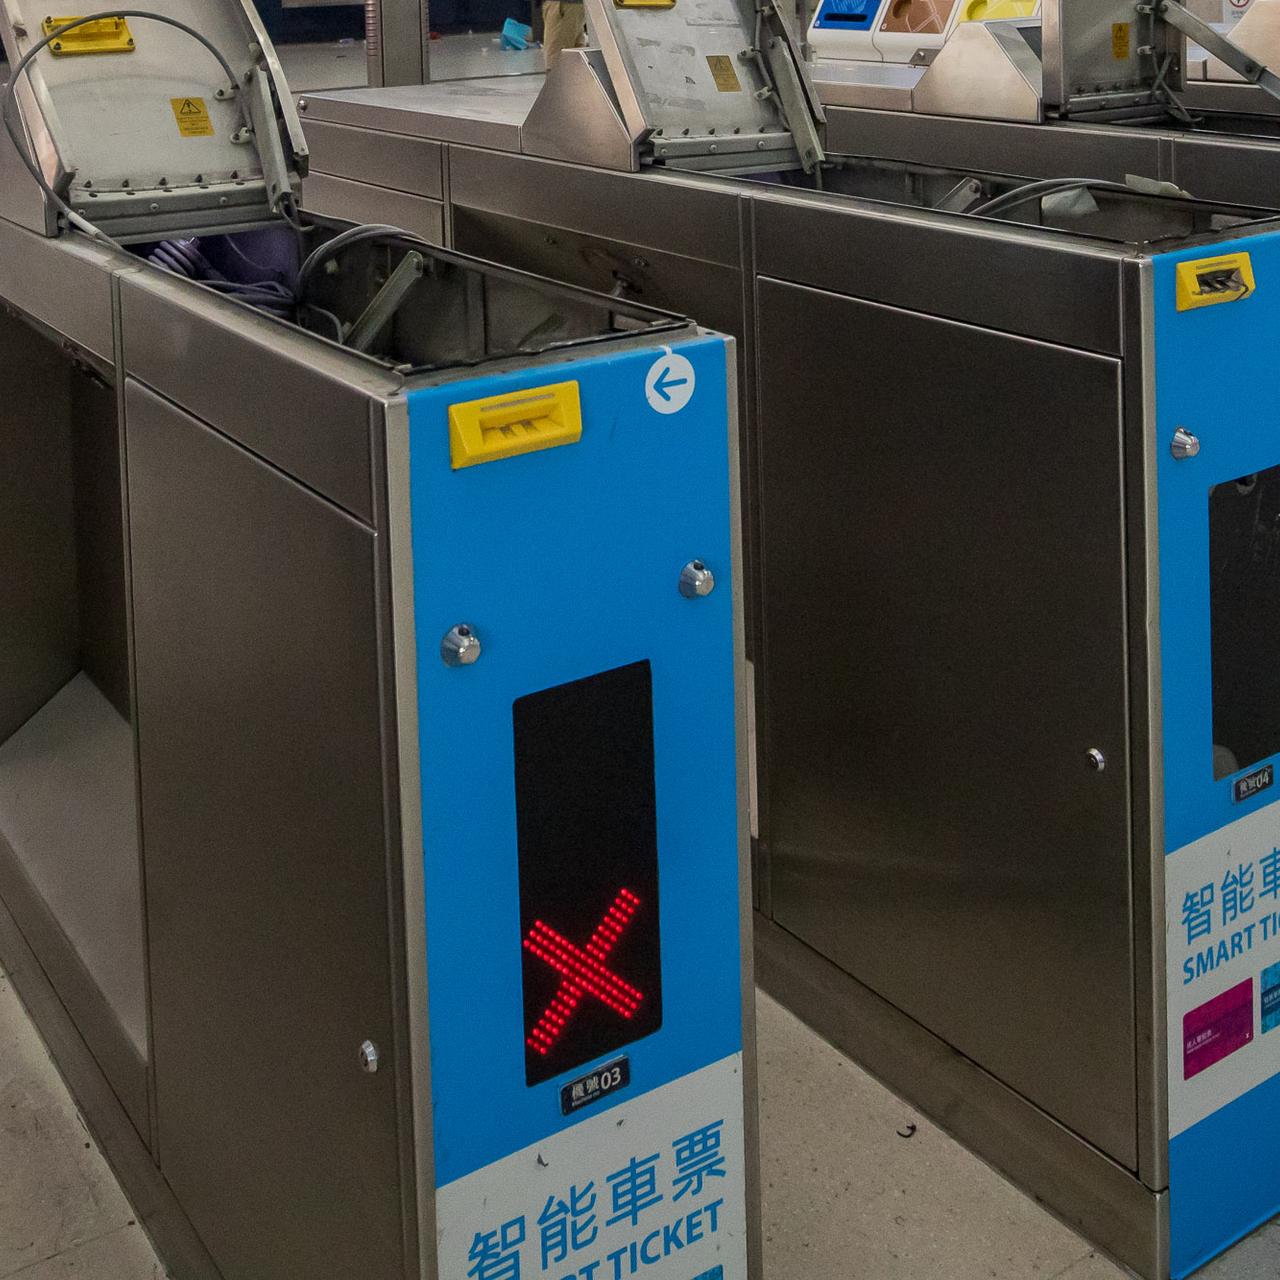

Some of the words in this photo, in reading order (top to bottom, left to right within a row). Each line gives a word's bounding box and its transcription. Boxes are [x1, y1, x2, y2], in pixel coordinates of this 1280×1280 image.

[1183, 923, 1255, 985] SMART
[467, 1119, 727, 1280] 智能車票
[606, 1198, 724, 1274] TICKET
